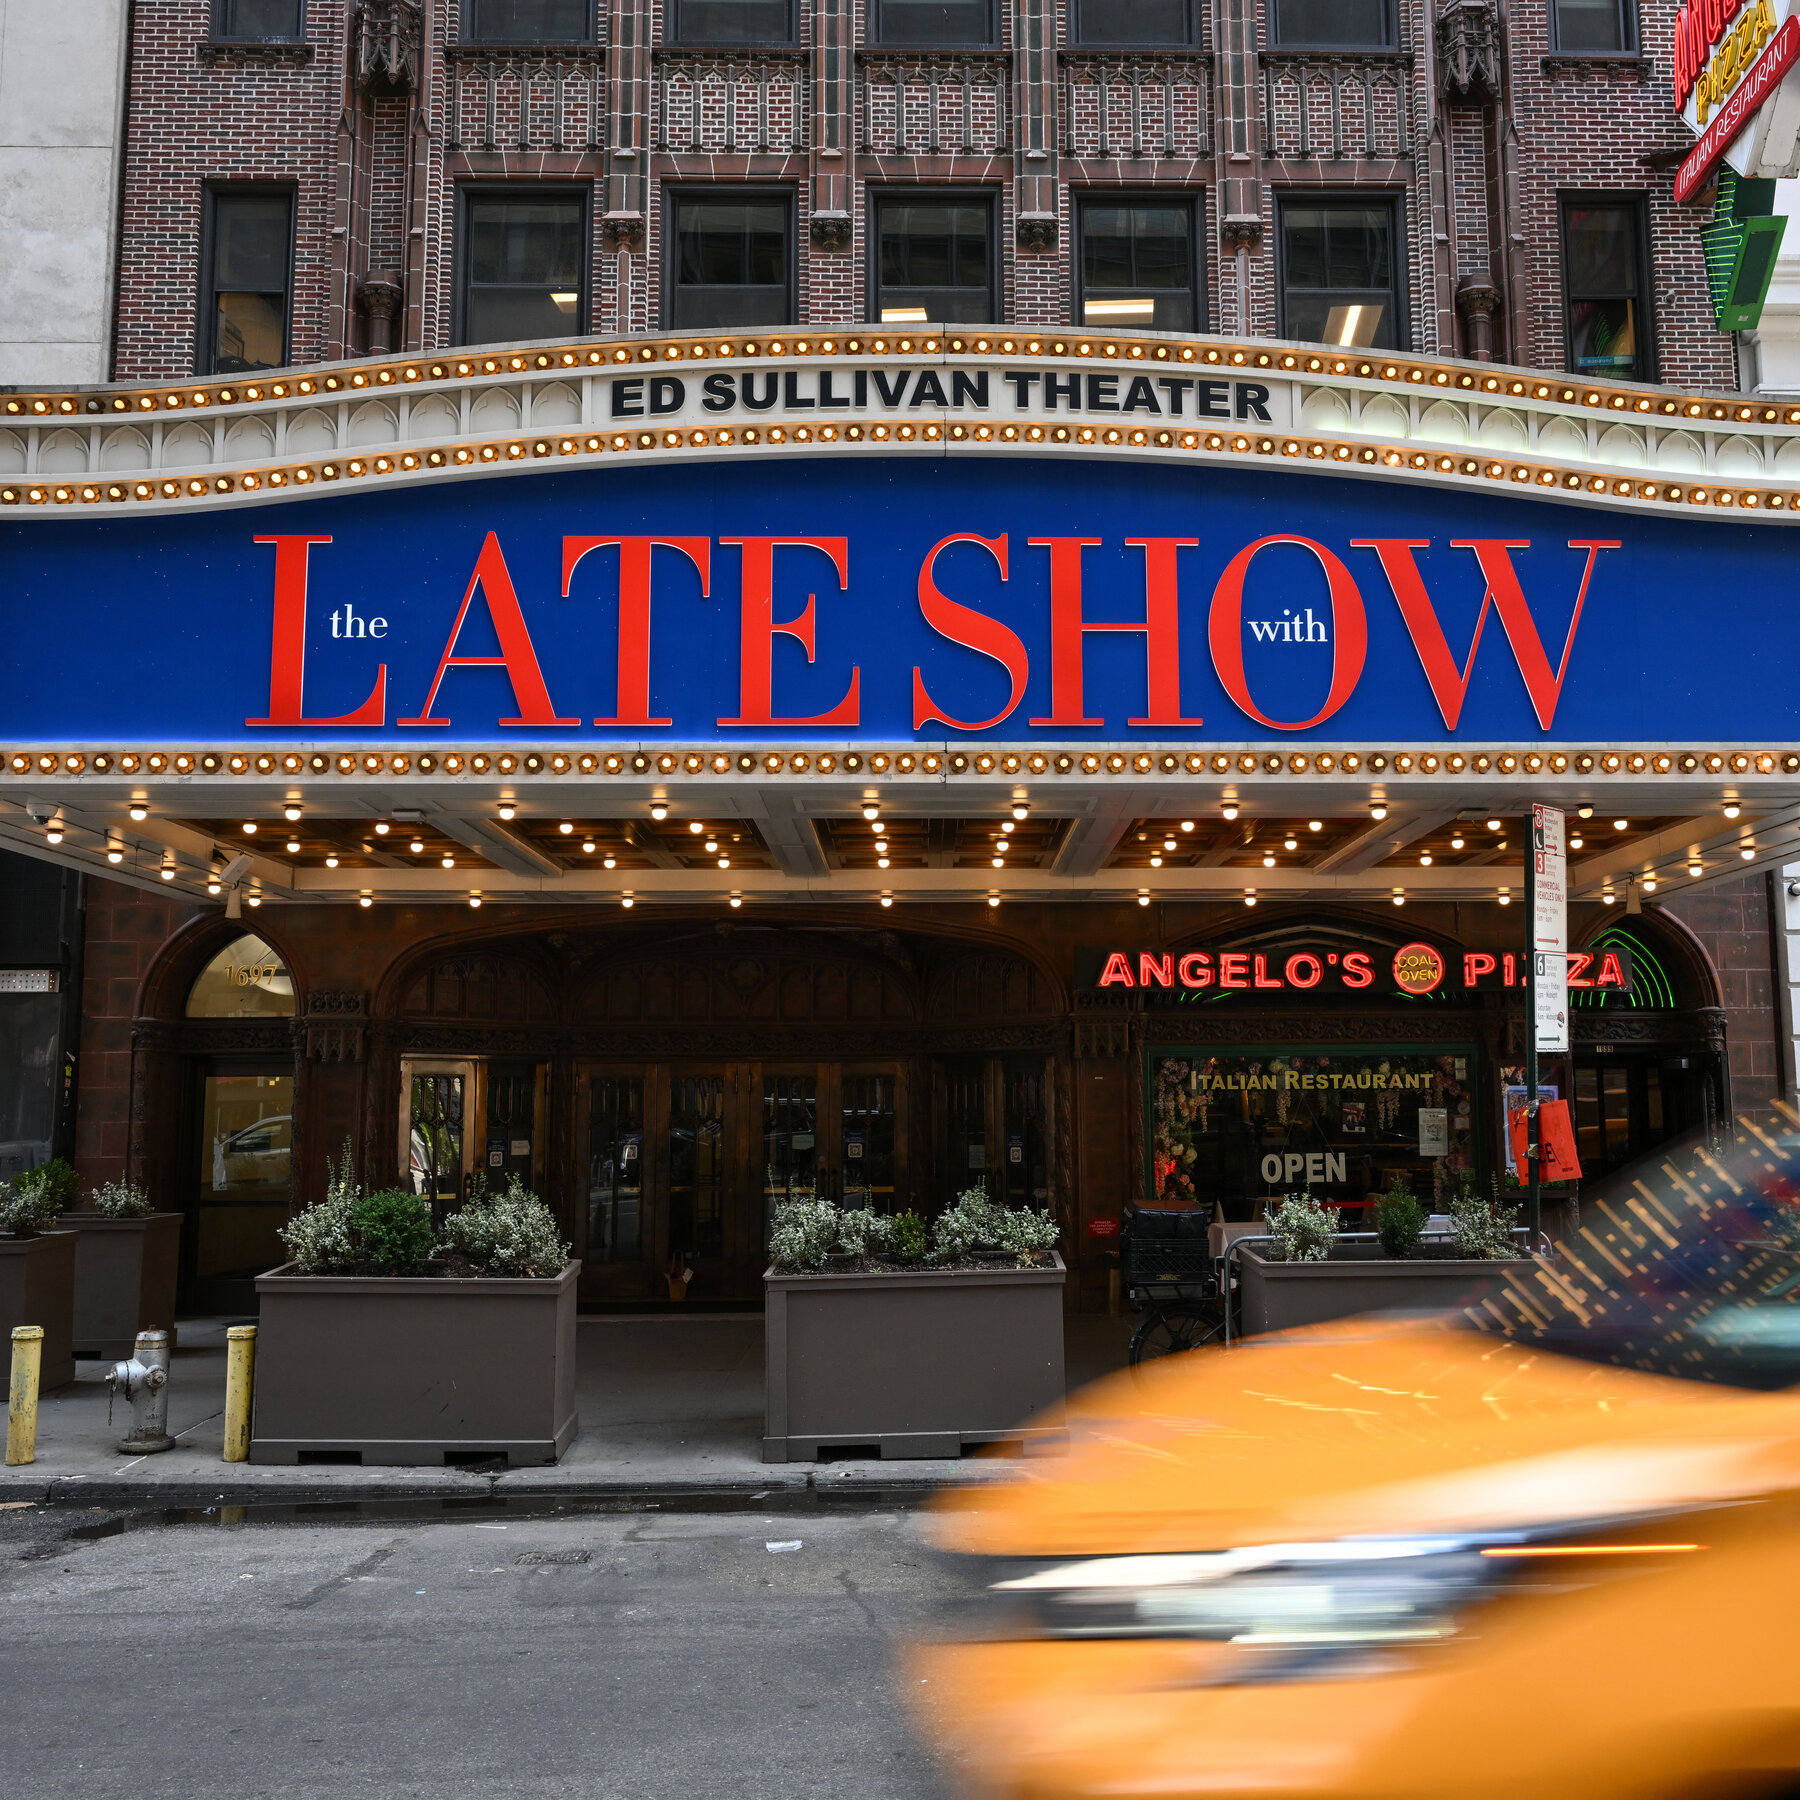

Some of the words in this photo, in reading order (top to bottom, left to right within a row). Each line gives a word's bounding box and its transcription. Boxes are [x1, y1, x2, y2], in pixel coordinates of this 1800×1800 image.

[1697, 0, 1773, 123] PIZZA
[1679, 130, 1713, 194] ITALIAN
[1715, 26, 1790, 146] RESTAURANT
[611, 376, 686, 418] ED
[701, 369, 989, 413] SULLIVAN
[1004, 371, 1273, 423] THEATER
[245, 530, 860, 727] LATE
[912, 531, 1622, 731] SHOW
[329, 603, 389, 640] the
[1247, 608, 1329, 644] with
[1537, 854, 1544, 873] 3
[1537, 880, 1560, 891] COMMERCIAL
[1537, 891, 1555, 902] VEHICLES
[1555, 893, 1564, 903] ONLY
[1098, 951, 1376, 989] ANGELO'S
[1463, 951, 1626, 988] PIZA
[1397, 955, 1438, 968] COAL
[1399, 968, 1438, 982] OVEN
[1537, 955, 1544, 975] 6
[225, 964, 278, 987] 1697
[1190, 1070, 1277, 1090] ITALIAN
[1284, 1070, 1434, 1090] RESTAURANT
[1261, 1152, 1347, 1184] OPEN
